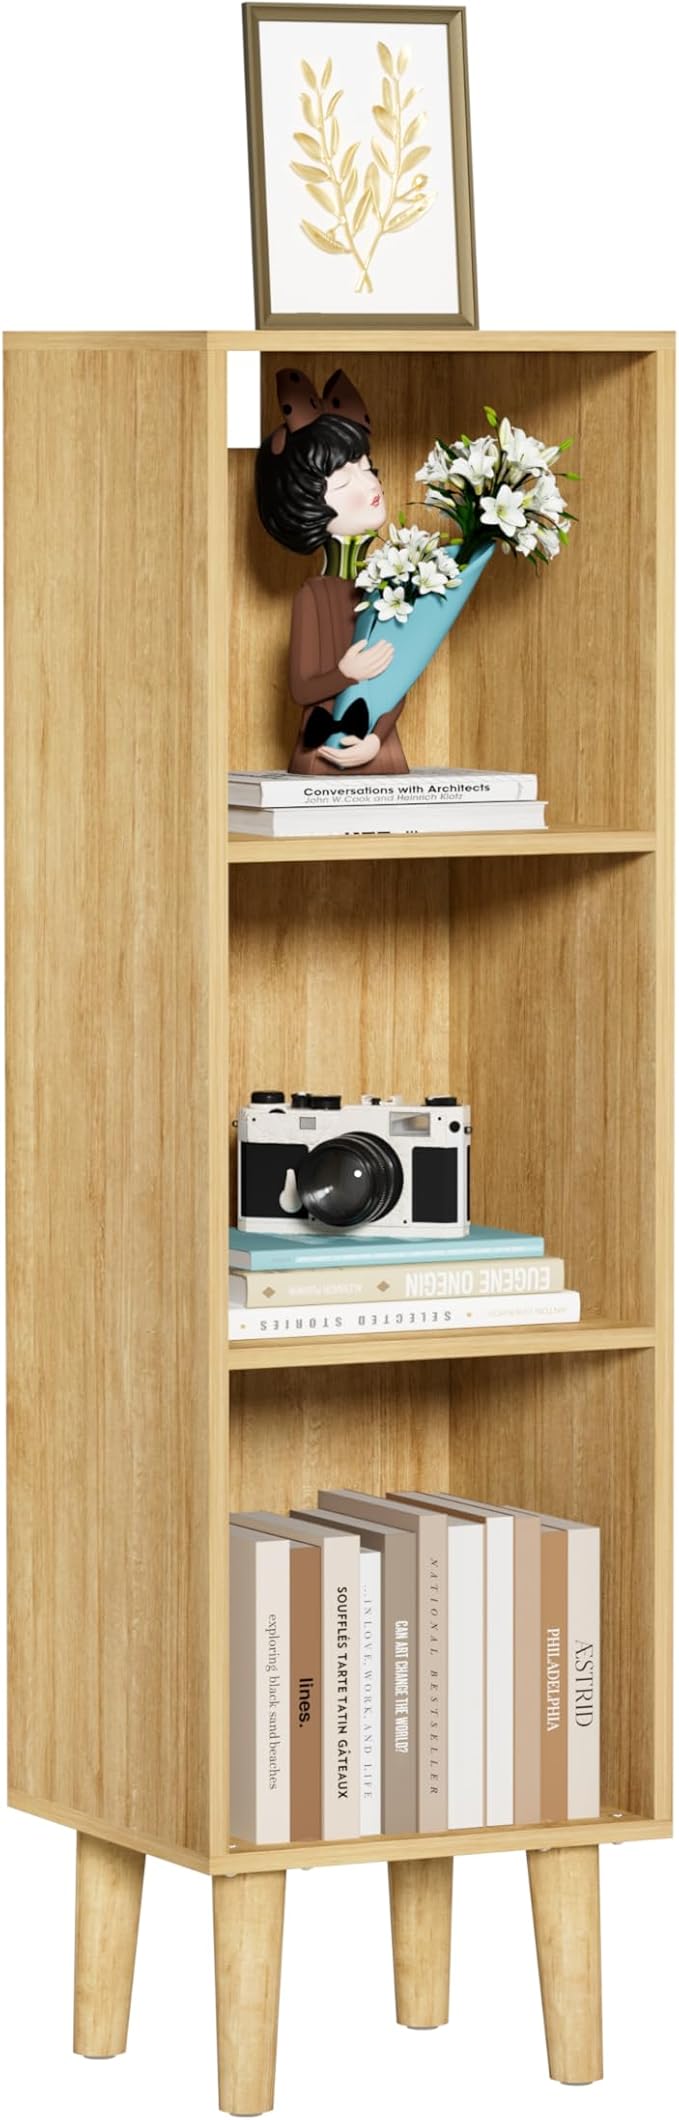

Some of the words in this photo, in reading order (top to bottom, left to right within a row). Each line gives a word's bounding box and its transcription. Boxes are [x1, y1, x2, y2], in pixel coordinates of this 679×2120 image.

[304, 787, 394, 796] Conversations
[428, 784, 490, 792] Architects
[304, 796, 329, 804] John
[405, 1270, 474, 1297] ONEGIN
[479, 1266, 551, 1294] EUGENE
[260, 1317, 342, 1331] STORIES
[358, 1311, 451, 1325] SELECTED
[337, 1587, 350, 1648] SOUFFLÉS
[430, 1559, 438, 1655] NATIONAL
[265, 1614, 280, 1672] exploring
[395, 1621, 408, 1639] CAN
[395, 1642, 408, 1657] ART
[338, 1653, 347, 1692] TARTE
[395, 1661, 408, 1696] CHANGE
[547, 1629, 560, 1731] PHILADELPHIA
[268, 1676, 280, 1707] black
[299, 1678, 313, 1727] lines.
[395, 1698, 408, 1714] THE
[268, 1711, 280, 1739] sand
[338, 1696, 347, 1733] TATIN
[364, 1724, 372, 1753] AND
[395, 1717, 408, 1752] WORLD?
[430, 1670, 438, 1793] BESTSELLER
[268, 1740, 280, 1791] beaches
[364, 1764, 372, 1798] LIFE
